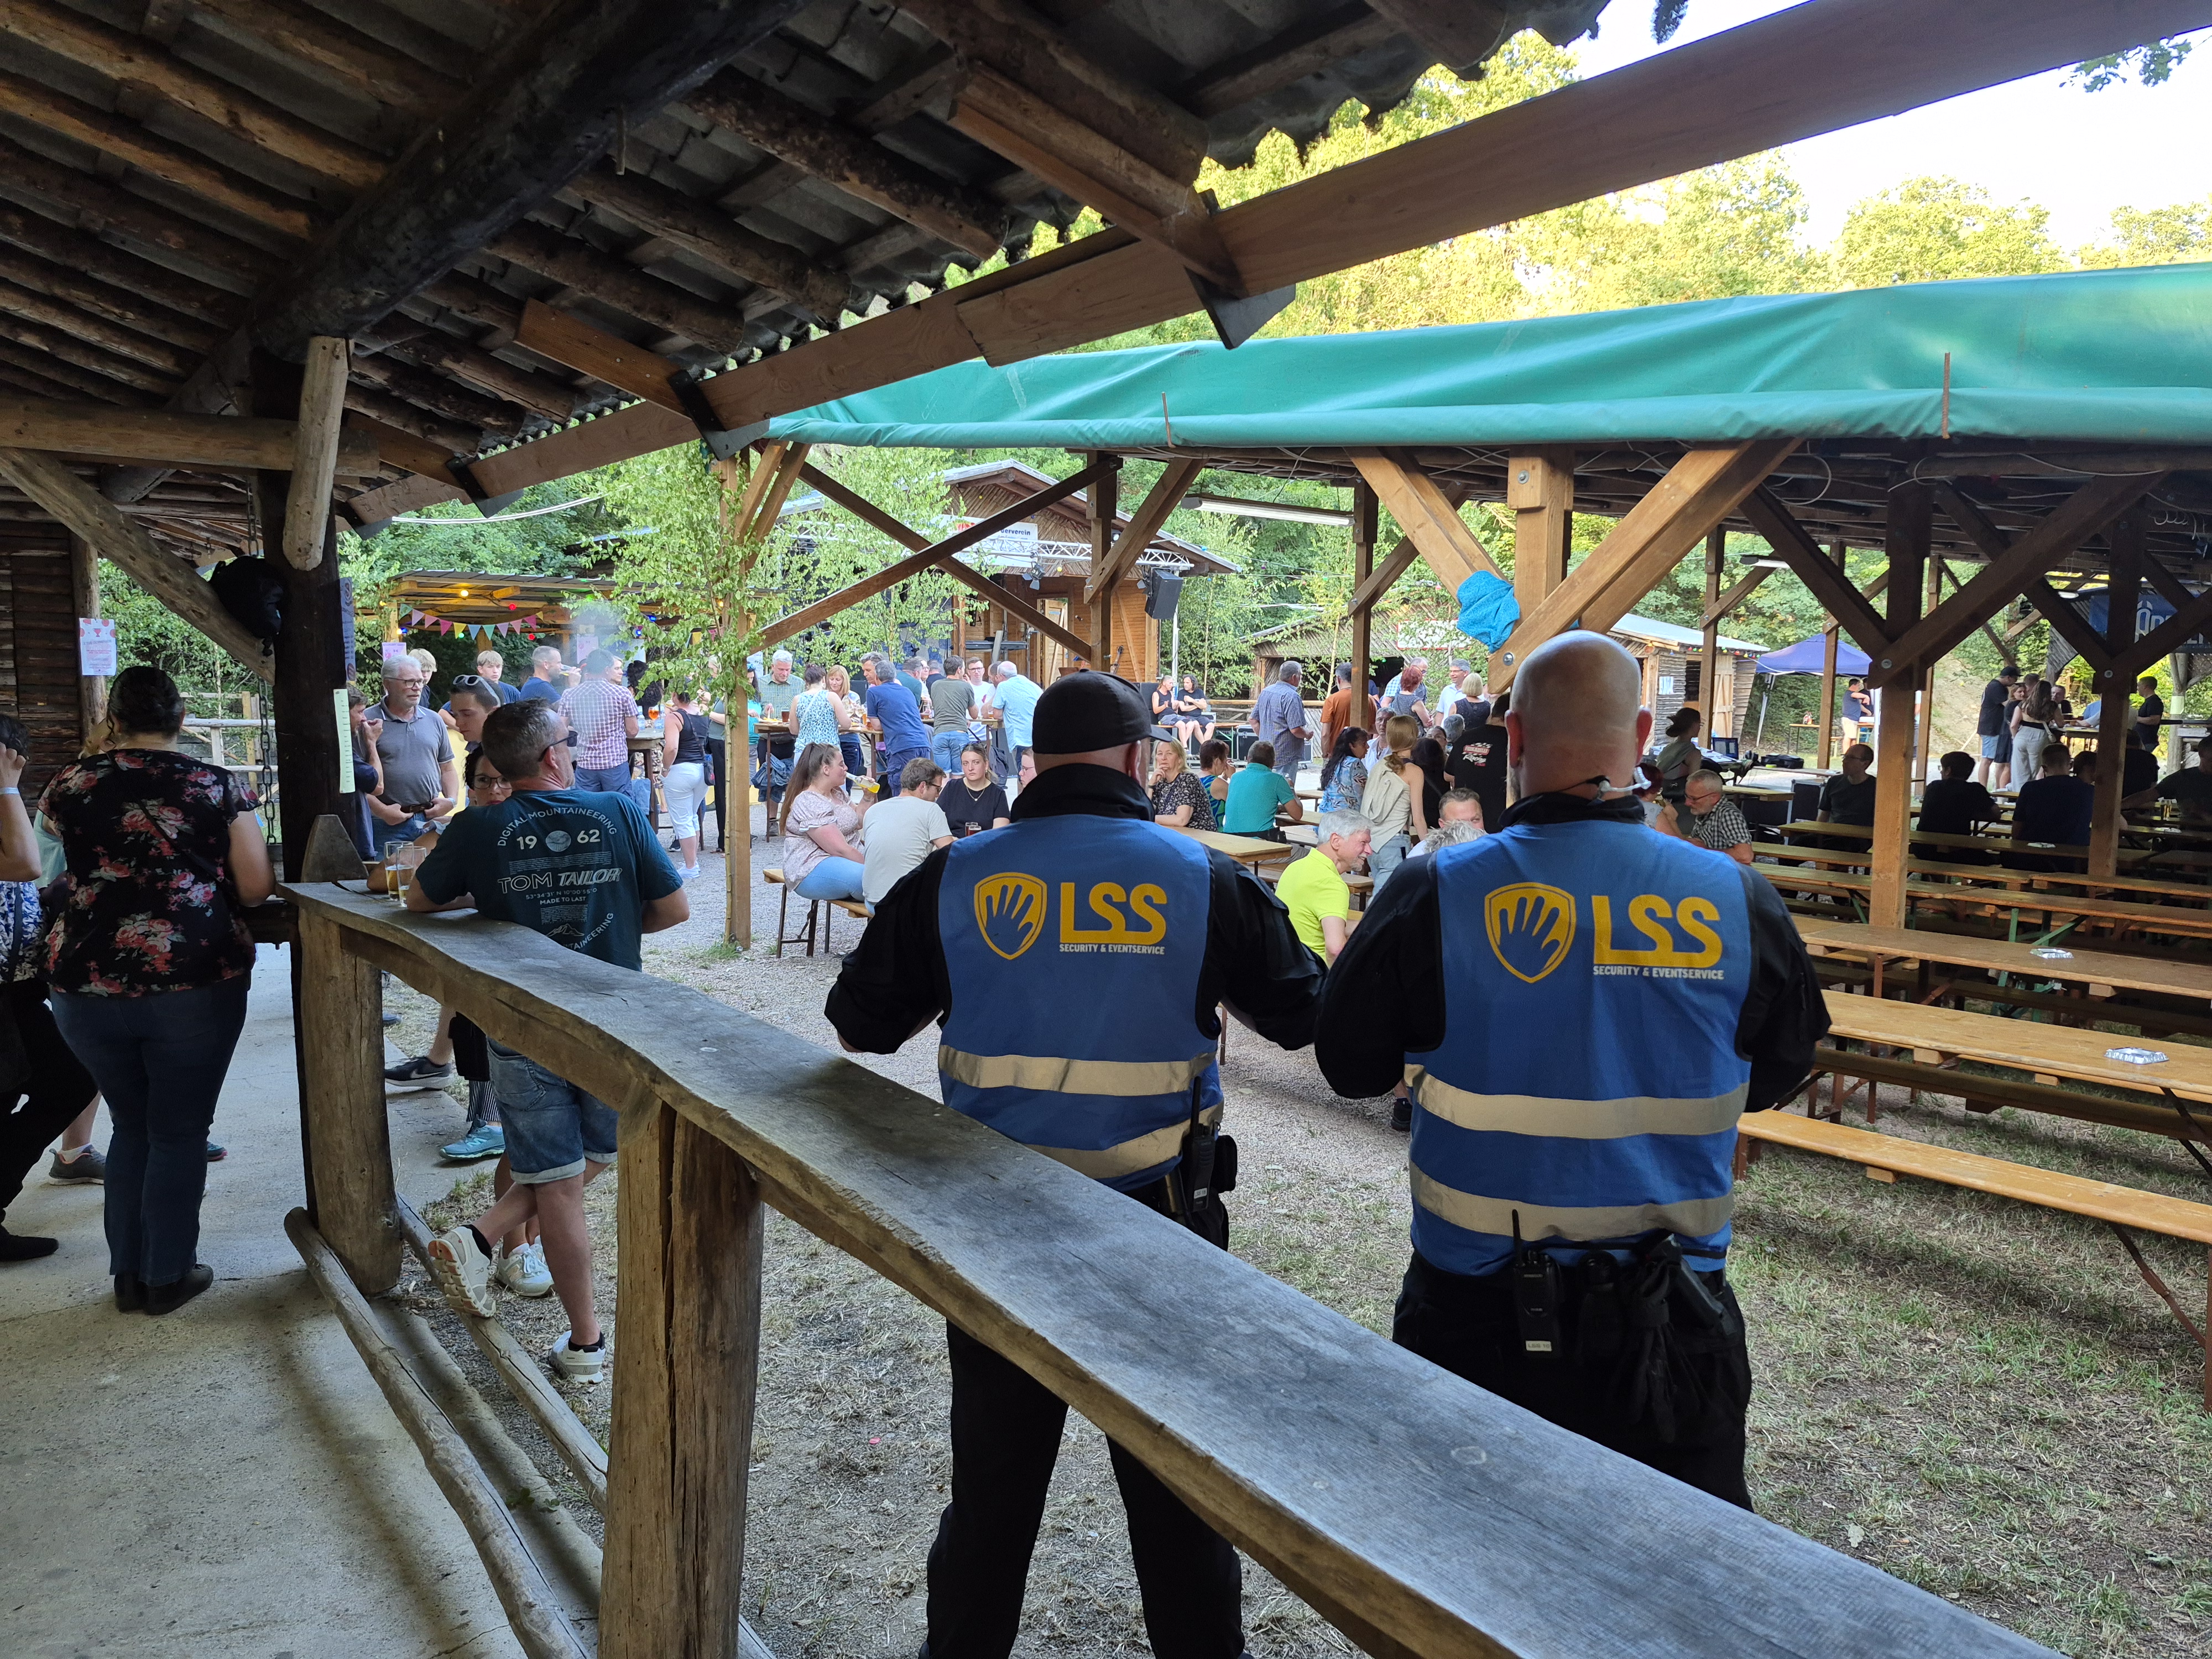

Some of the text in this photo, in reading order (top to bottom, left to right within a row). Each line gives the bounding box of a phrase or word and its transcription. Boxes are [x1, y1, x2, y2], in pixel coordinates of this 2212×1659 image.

[498, 807, 617, 846] DIGITAL MOUNTAINEERING
[516, 829, 601, 850] 19 62
[498, 868, 623, 894] TOM TAILOR
[1060, 882, 1167, 945] LSS
[1591, 894, 1723, 968] LSS
[1059, 943, 1165, 954] SECURITY & EVENTSERVICE
[1593, 965, 1724, 980] SECURITY & EVENTSERVICE
